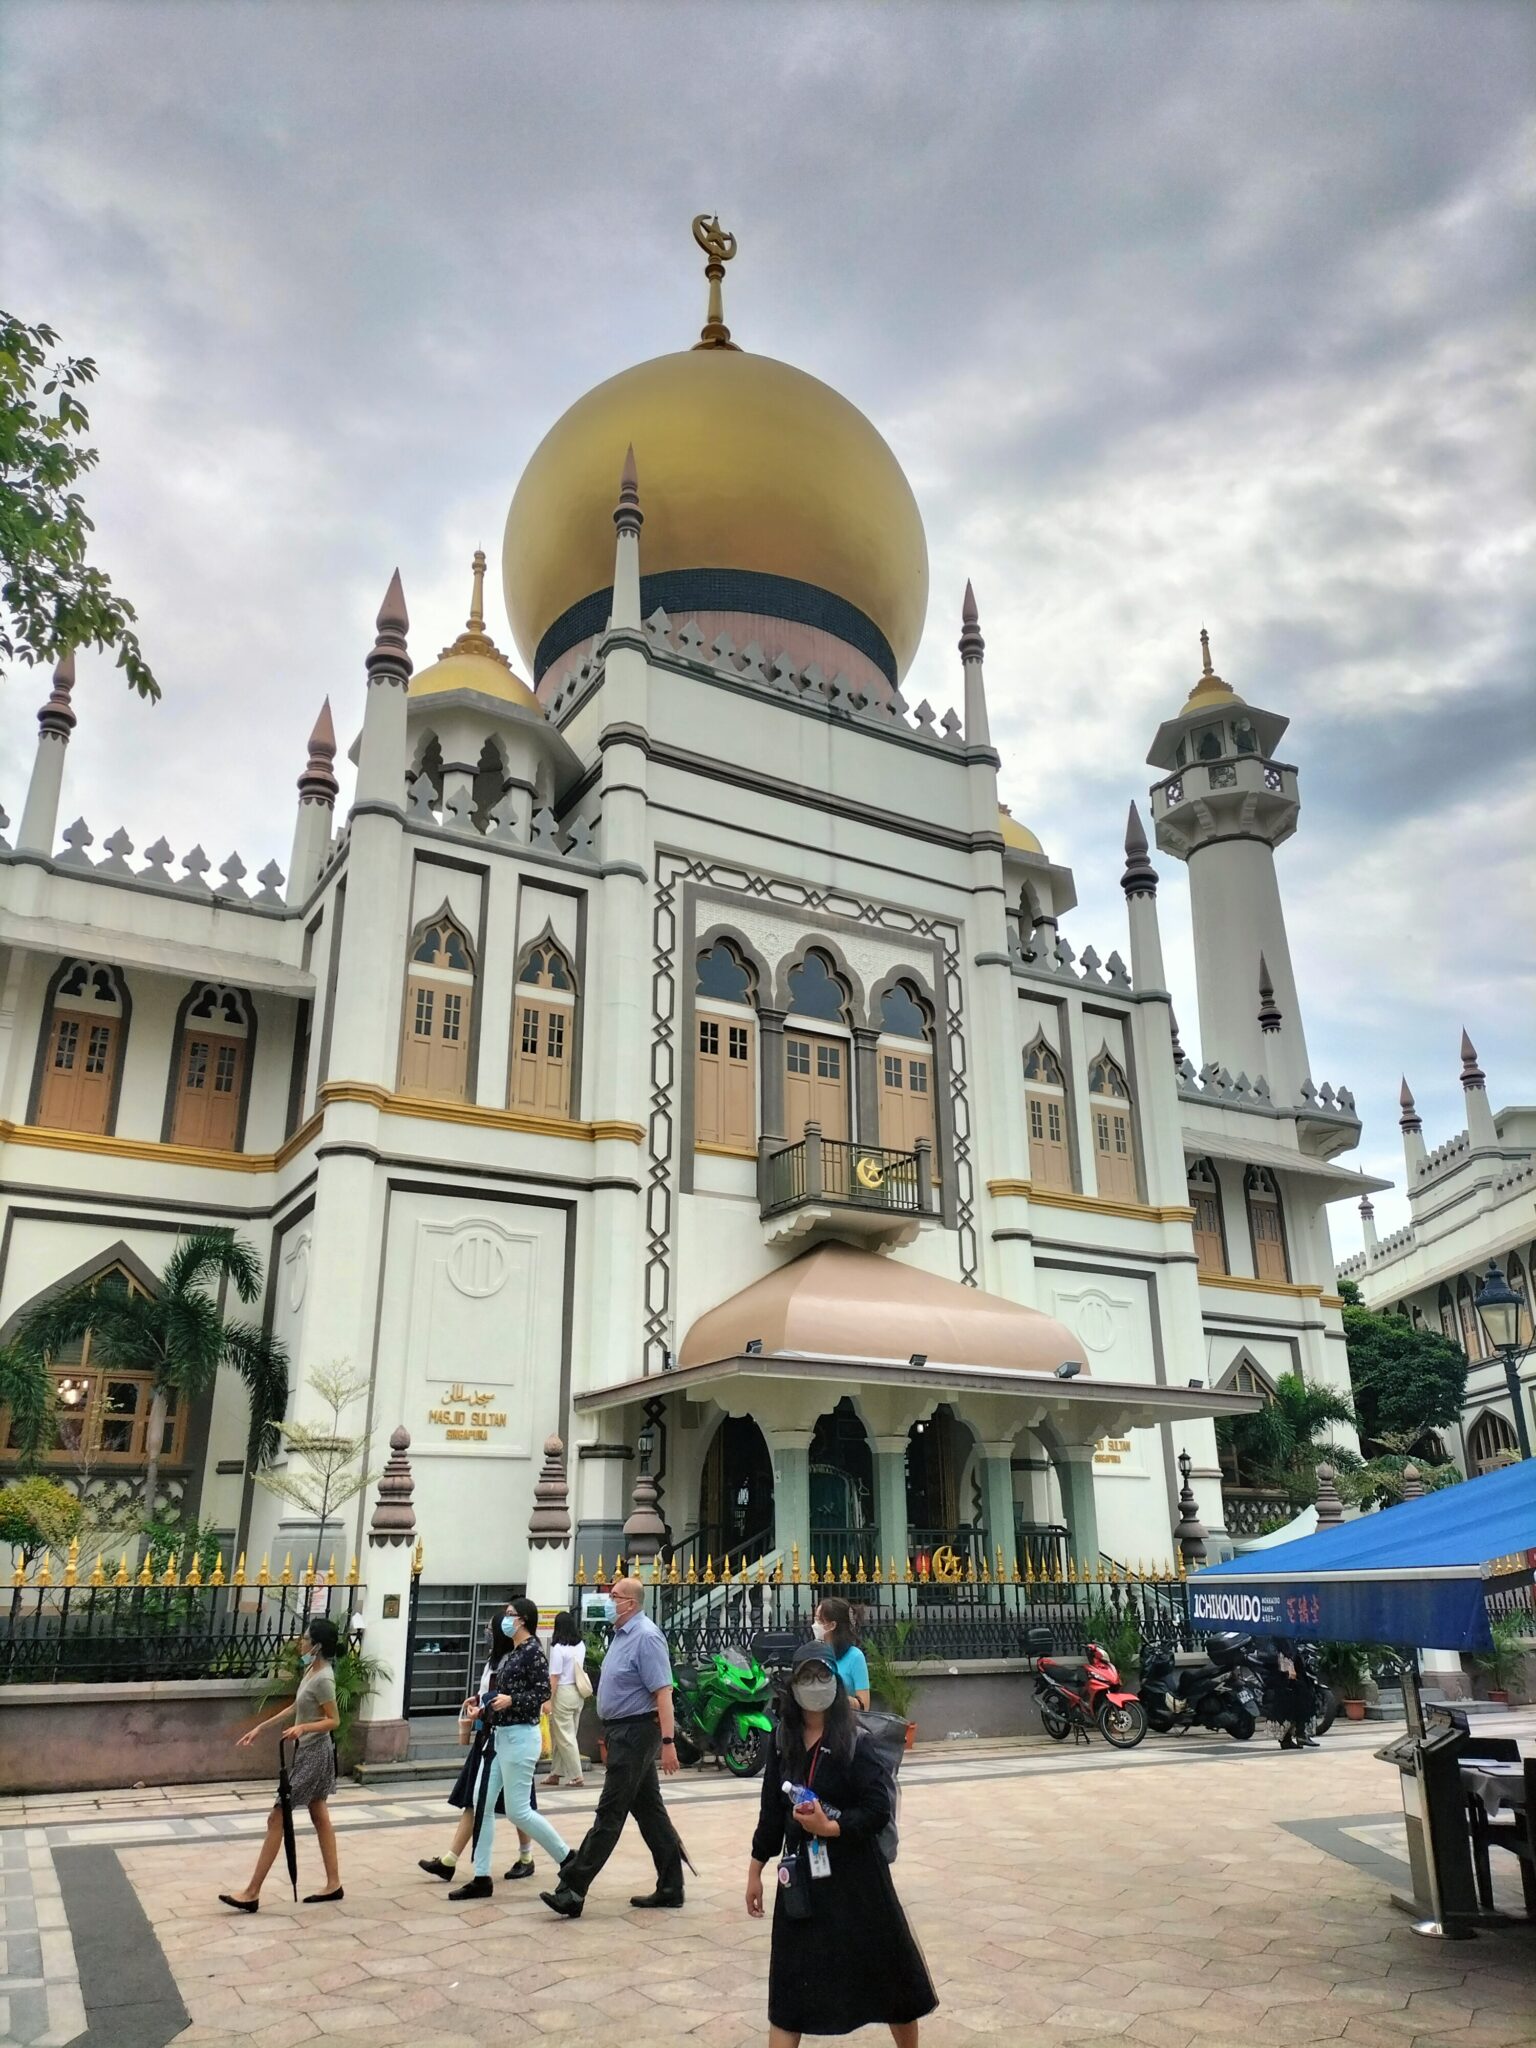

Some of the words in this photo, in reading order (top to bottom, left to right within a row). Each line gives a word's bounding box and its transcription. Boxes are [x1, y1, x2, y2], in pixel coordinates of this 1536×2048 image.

[428, 1410, 465, 1426] MASJID
[471, 1412, 507, 1427] SULTAN
[1193, 1593, 1261, 1623] ICHIKOKUDO
